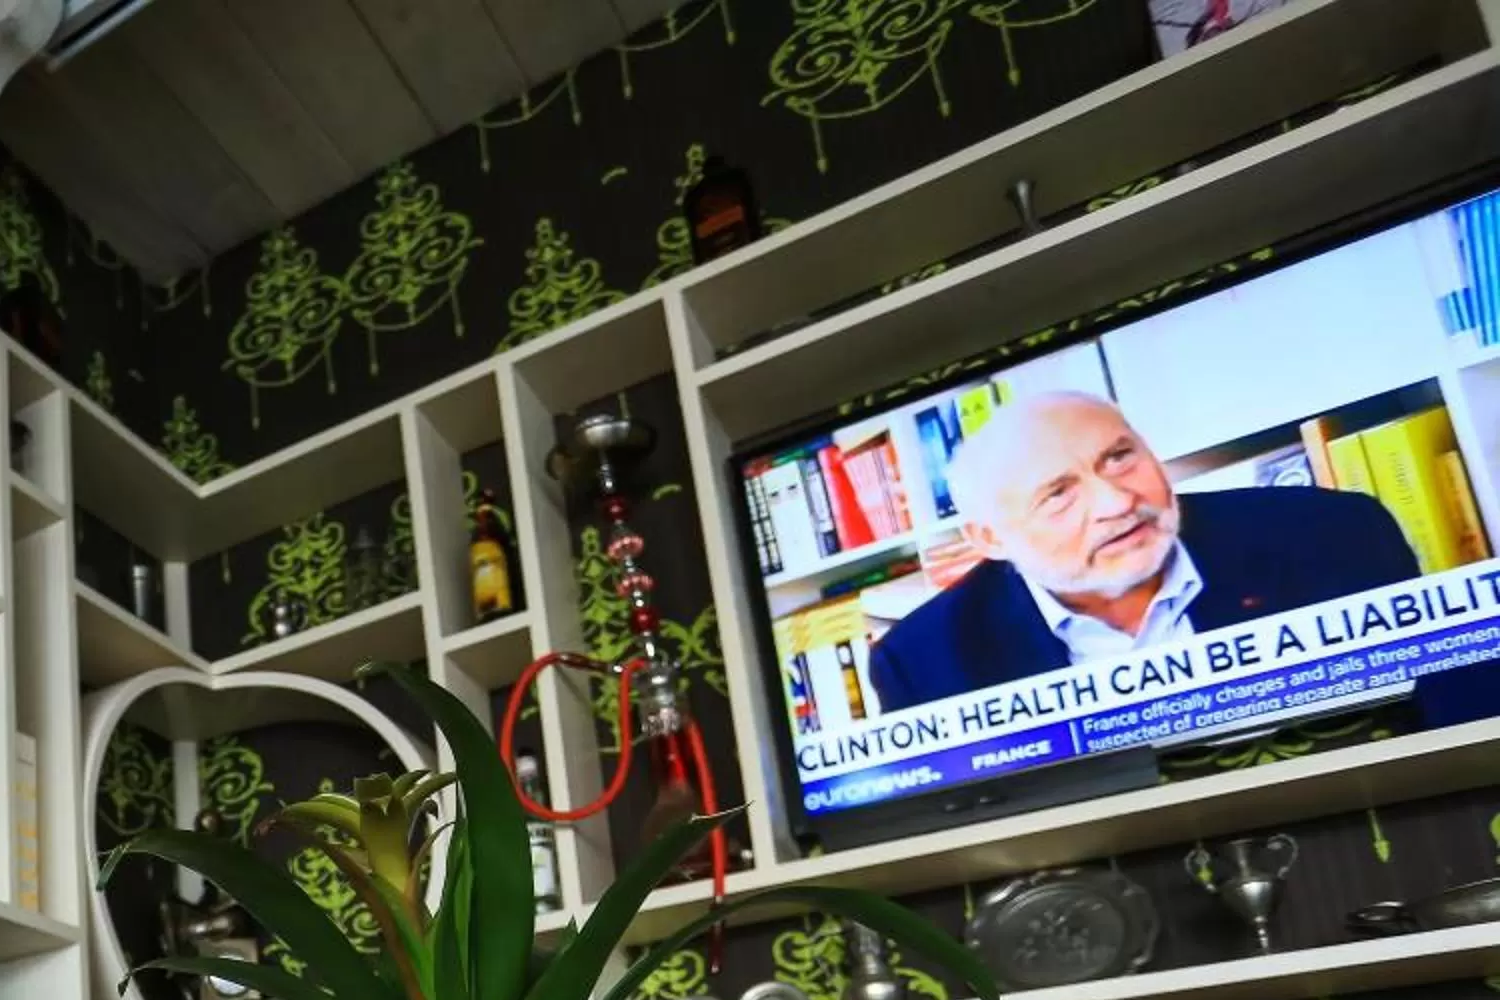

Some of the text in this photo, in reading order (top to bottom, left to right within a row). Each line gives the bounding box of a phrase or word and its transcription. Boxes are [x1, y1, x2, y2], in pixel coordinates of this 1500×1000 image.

[799, 712, 949, 772] CLINTON:
[960, 673, 1099, 734] HEALTH
[1110, 649, 1194, 694] CAN
[1205, 633, 1261, 673] BE
[1275, 624, 1306, 658] A
[1083, 709, 1138, 733] France
[1141, 689, 1211, 721] officially
[1216, 675, 1286, 706] charges
[1289, 664, 1326, 687] and
[1327, 657, 1366, 681] jails
[1368, 643, 1422, 667] three
[1086, 722, 1171, 750] suspected
[1173, 712, 1191, 731] of
[1368, 665, 1407, 688] and
[971, 740, 1052, 769] FRANCE
